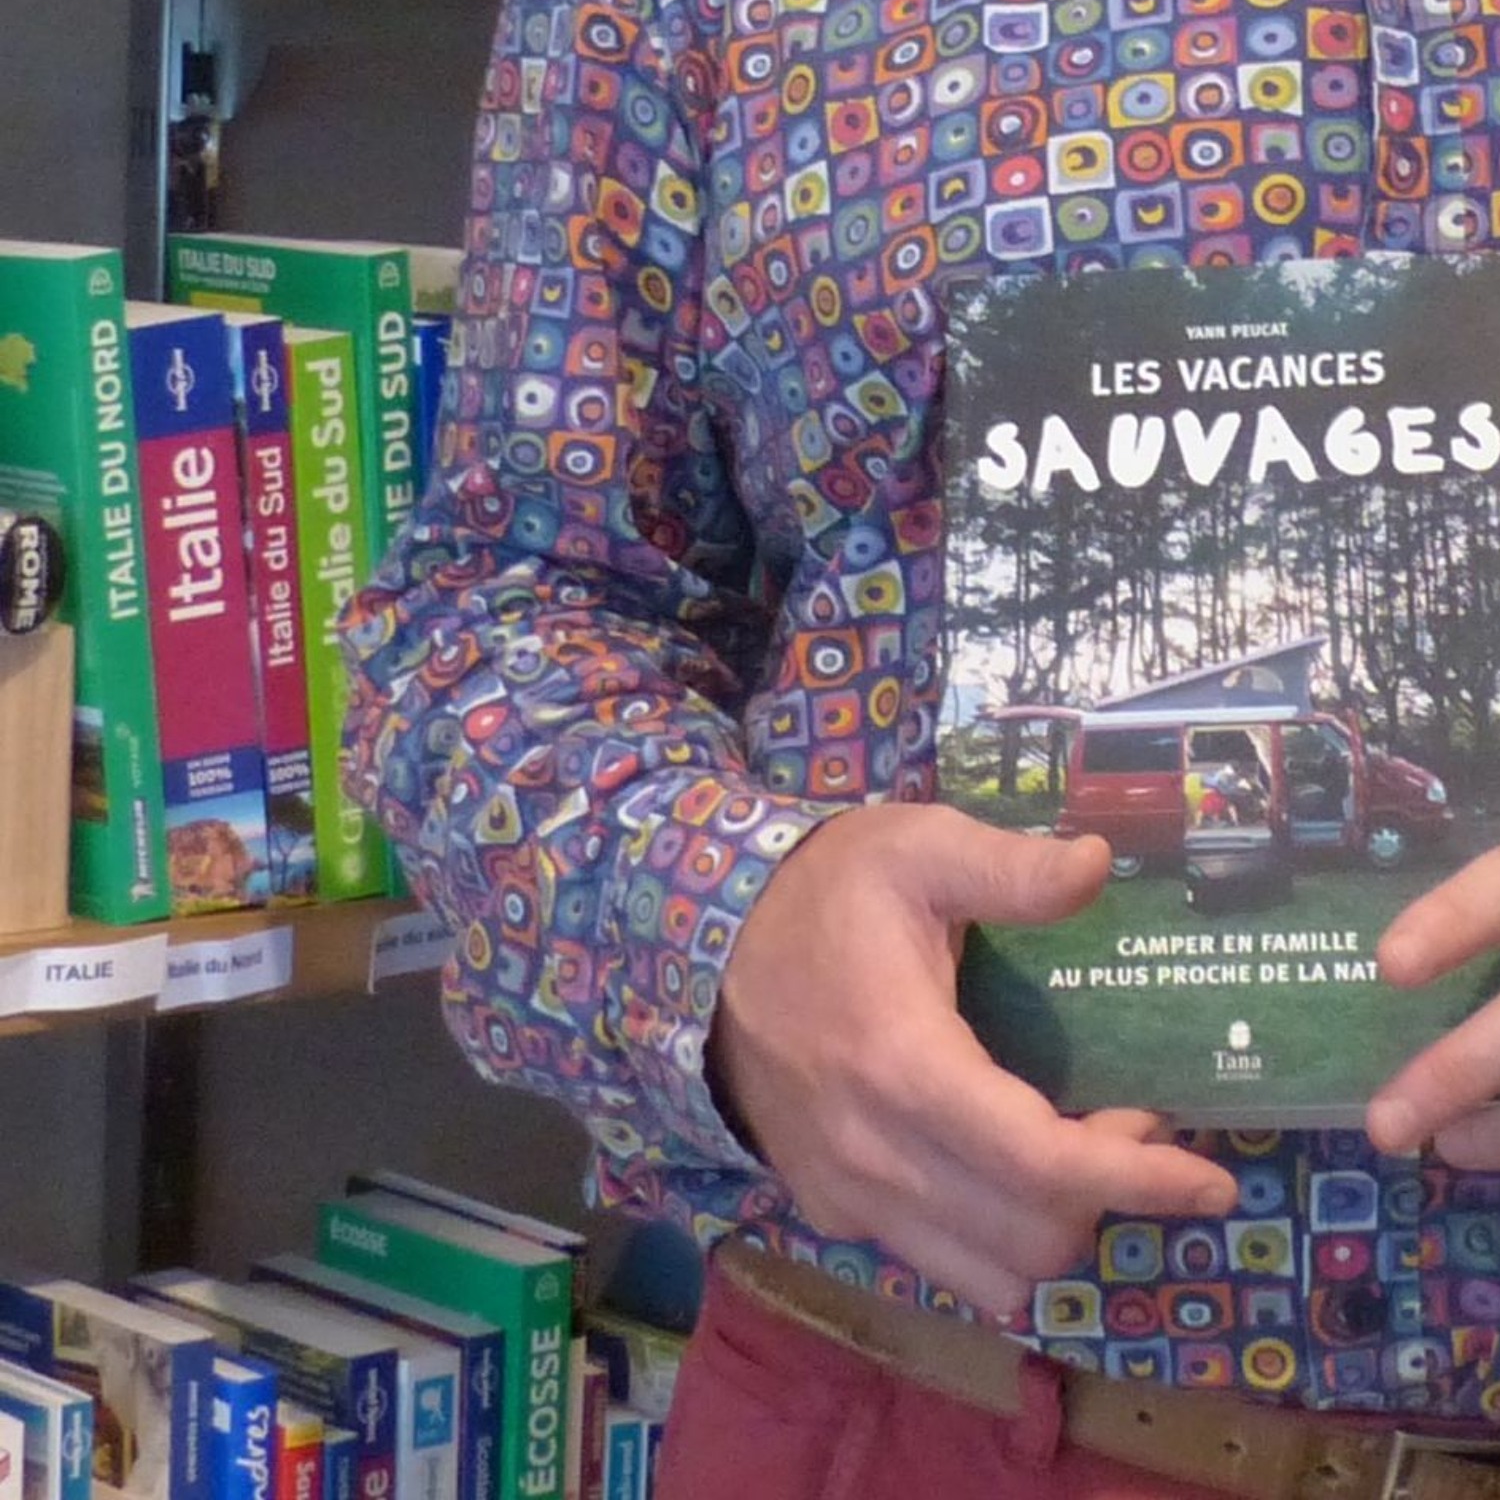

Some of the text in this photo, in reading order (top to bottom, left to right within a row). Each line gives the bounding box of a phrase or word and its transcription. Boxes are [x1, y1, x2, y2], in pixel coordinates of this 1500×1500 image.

[178, 249, 277, 280] ITALIE DU SUD
[1186, 323, 1289, 340] YANN PEUCAT
[379, 310, 412, 473] DU SUD
[1091, 352, 1386, 396] LES VACANCES
[305, 356, 346, 448] Sud
[91, 317, 140, 622] ITALIE DU NORD
[313, 459, 350, 514] du
[162, 447, 225, 622] Italie
[255, 445, 294, 667] Italie du Sud
[16, 524, 41, 631] ROME
[186, 763, 234, 788] 100%
[268, 763, 310, 785] 100%
[138, 799, 154, 880] MICHELIN
[45, 950, 263, 982] ITALIE Italie du Nord
[1118, 931, 1359, 957] CAMPER EN FAMILLE
[1049, 961, 1379, 988] AU PLUS PROCHE DE LA NAT
[1213, 1051, 1263, 1071] Tana
[519, 1324, 562, 1497] ÉCOSSE
